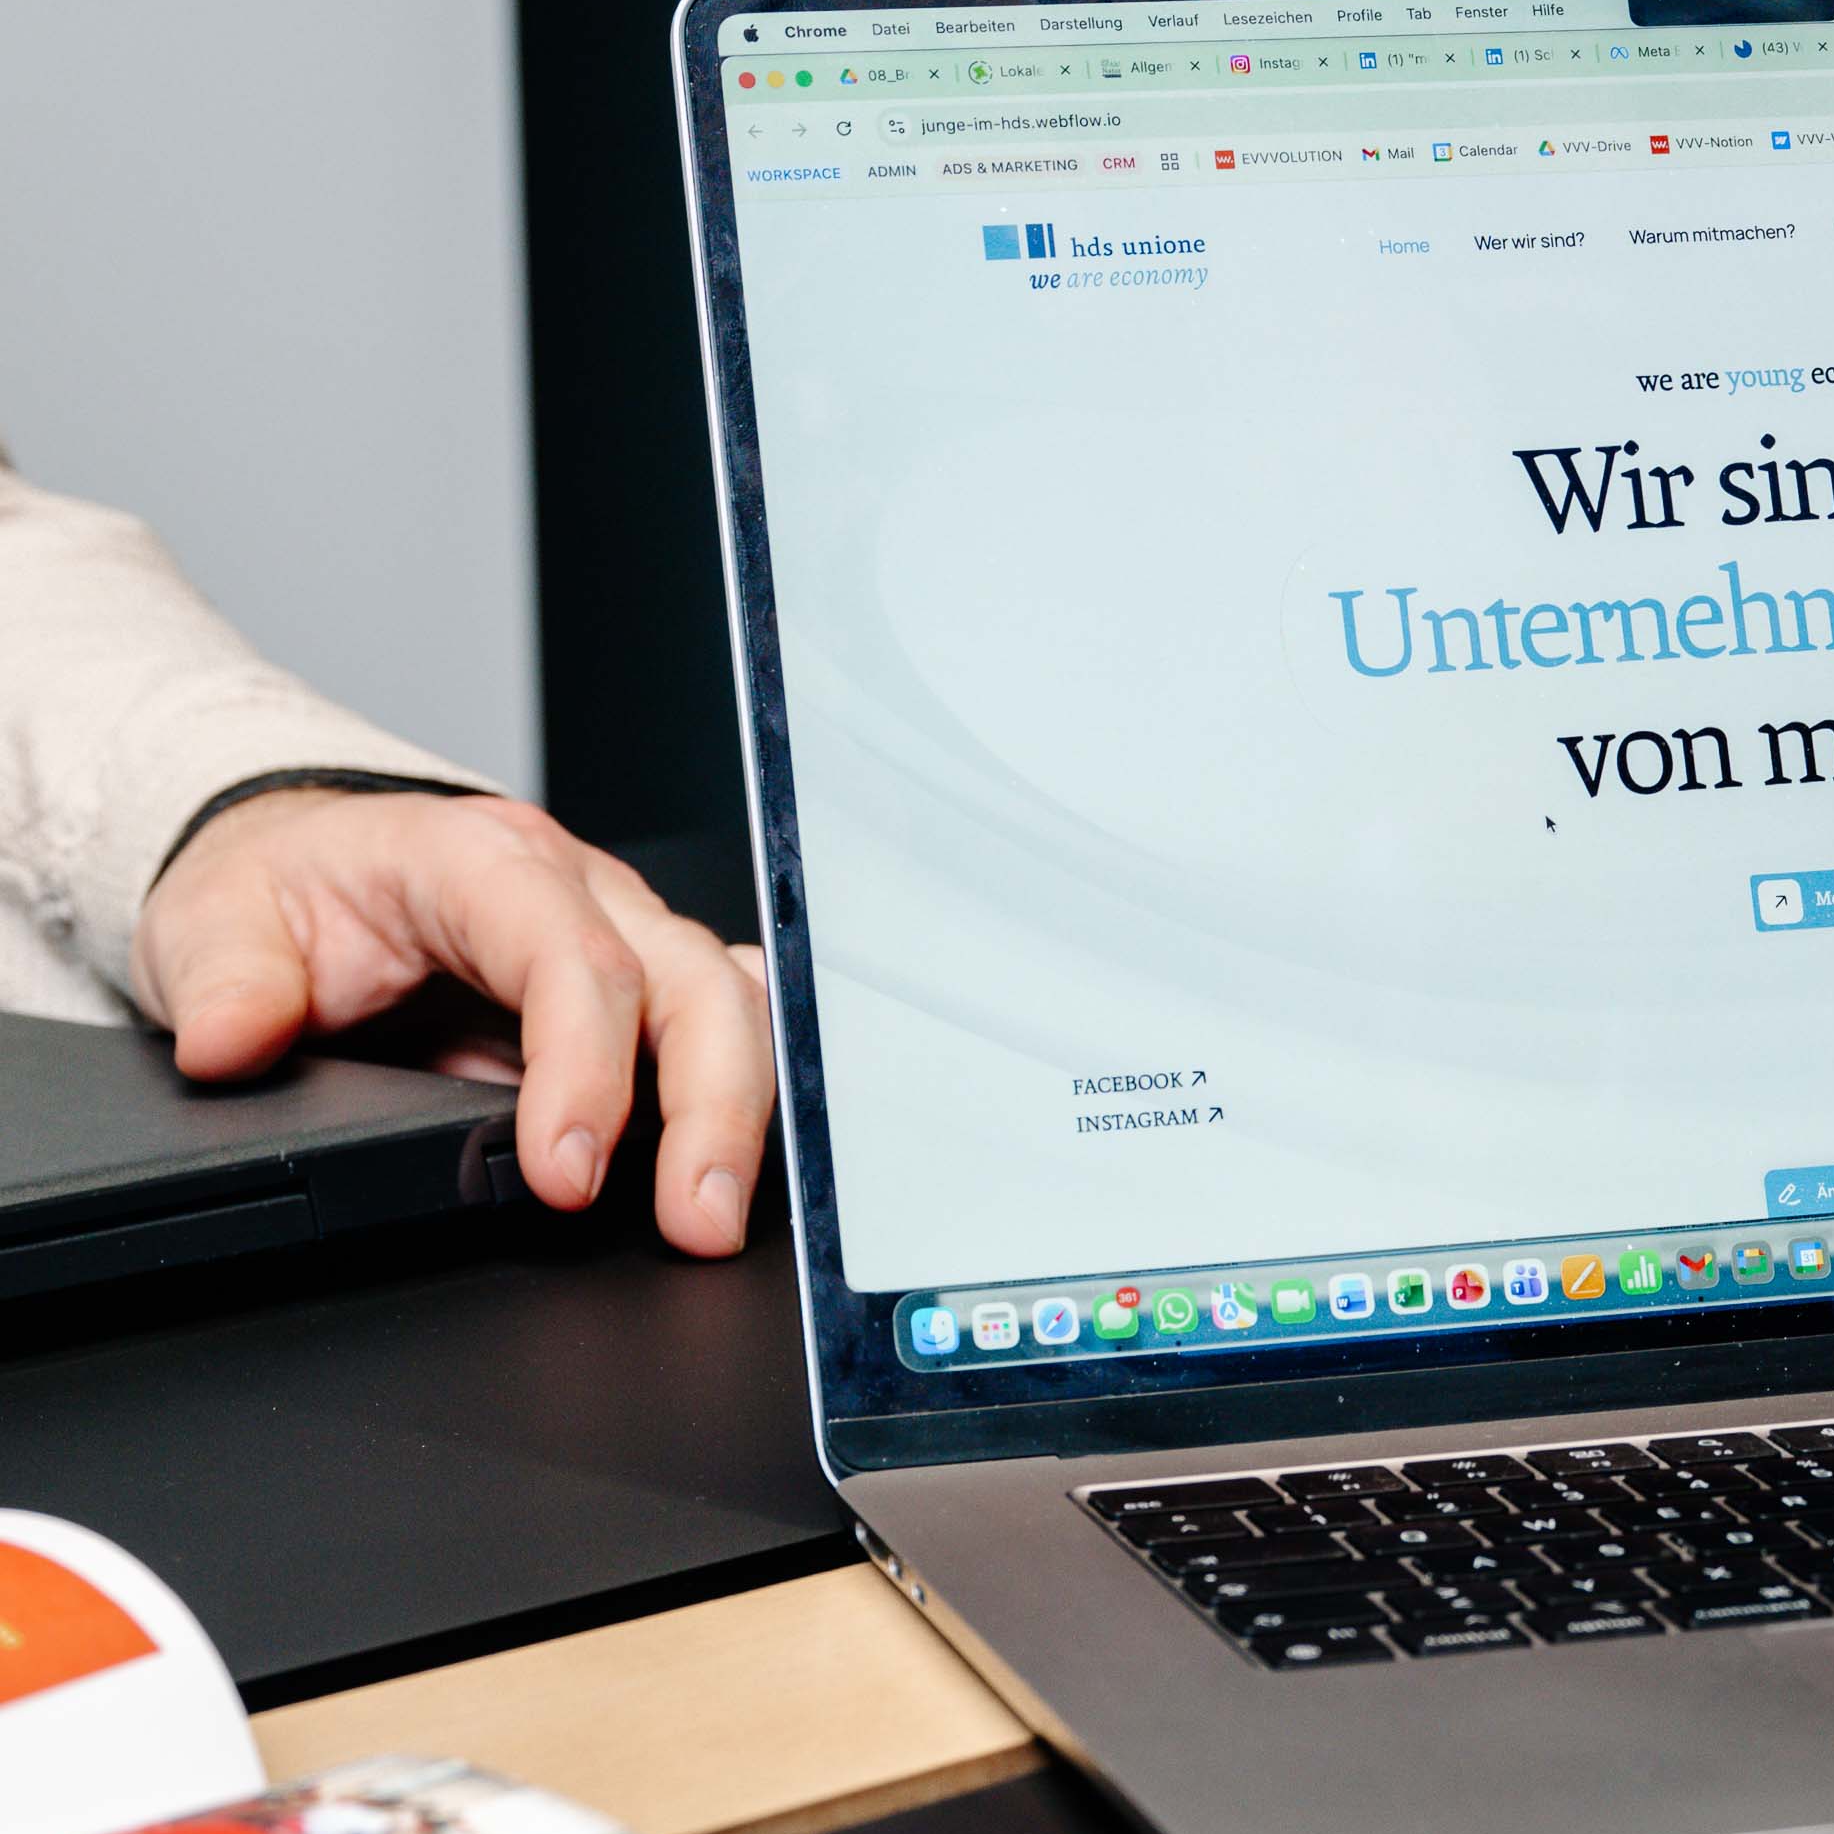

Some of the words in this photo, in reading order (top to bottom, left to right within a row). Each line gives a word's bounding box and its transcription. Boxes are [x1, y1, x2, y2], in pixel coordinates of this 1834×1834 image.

[785, 26, 846, 38] Chrome
[872, 23, 910, 35] Datei
[936, 20, 1015, 33] Bearbeiten
[1040, 17, 1122, 31] Darstellung
[1148, 14, 1198, 27] Verlauf
[1224, 11, 1312, 25] Lesezeichen
[1337, 9, 1382, 22] Profile
[1406, 7, 1431, 20] Tab
[1456, 7, 1508, 18] Fenster
[1532, 4, 1564, 15] Hilfe
[1639, 47, 1670, 57] Meta
[1763, 42, 1788, 55] (43)
[1388, 54, 1403, 67] (1)
[1514, 50, 1529, 63] (1)
[922, 113, 1120, 135] junge-im-hds.webflow.io
[1563, 141, 1631, 153] VVV-Drive
[1676, 136, 1752, 149] VVV-Notion
[1388, 147, 1414, 159] Mail
[1459, 144, 1517, 157] Calendar
[1103, 157, 1135, 169] CRM
[1242, 151, 1342, 164] EVVVOLUTION
[868, 165, 916, 177] ADMIN
[943, 163, 972, 175] ADS
[977, 162, 987, 173] &
[992, 159, 1078, 173] MARKETING
[748, 168, 840, 181] WORKSPACE
[1629, 230, 1689, 244] Warum
[1693, 224, 1795, 242] mitmachen?
[1071, 236, 1113, 257] hds
[1122, 235, 1205, 255] unione
[1379, 240, 1430, 254] Home
[1474, 236, 1508, 250] Wer
[1512, 234, 1536, 249] wir
[1541, 232, 1584, 248] sind?
[1029, 274, 1060, 289] we
[1067, 271, 1103, 288] are
[1110, 268, 1208, 290] economy
[1636, 374, 1673, 392] we
[1681, 372, 1719, 390] are
[1725, 368, 1805, 396] young
[1512, 440, 1694, 535] Wir
[1557, 727, 1743, 798] von
[1073, 1072, 1183, 1095] FACEBOOK
[1077, 1108, 1199, 1133] INSTAGRAM
[1118, 1291, 1138, 1304] 361
